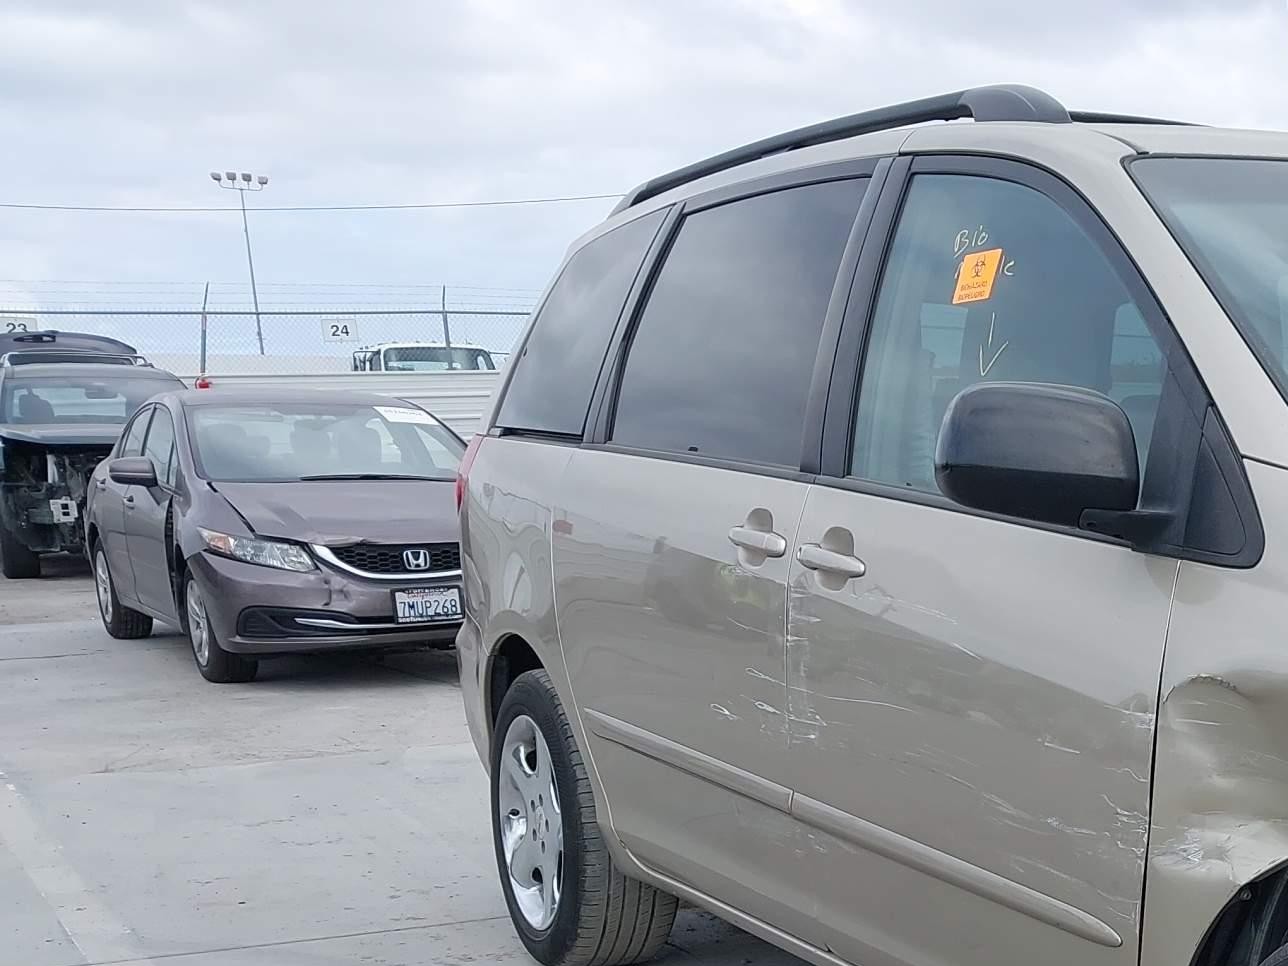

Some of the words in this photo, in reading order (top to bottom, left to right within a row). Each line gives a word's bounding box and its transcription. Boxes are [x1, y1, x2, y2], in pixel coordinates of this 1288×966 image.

[6, 322, 27, 333] 23
[330, 324, 350, 336] 24
[399, 599, 457, 616] 7MUP268
